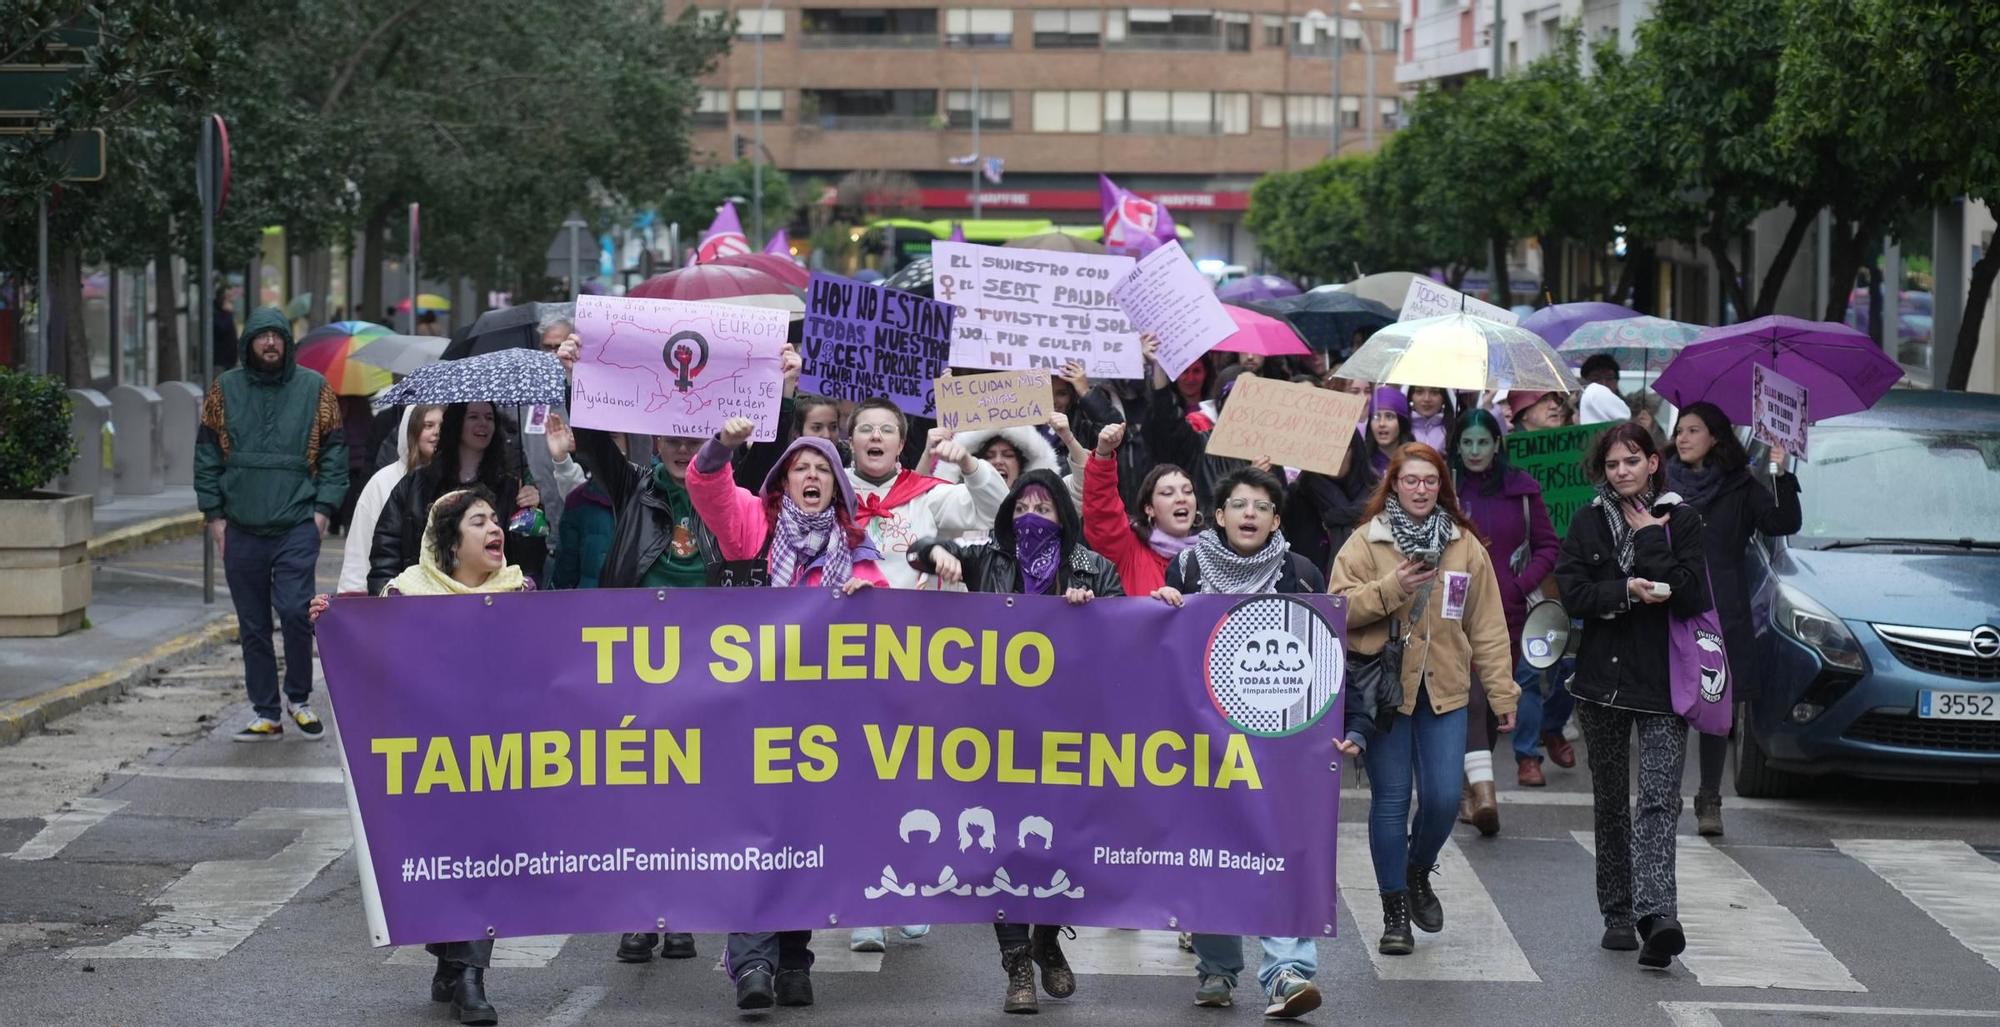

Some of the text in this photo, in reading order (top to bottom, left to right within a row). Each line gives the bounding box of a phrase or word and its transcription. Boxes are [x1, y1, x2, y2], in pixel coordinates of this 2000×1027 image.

[951, 254, 1110, 280] EL SINIESTRO CON
[812, 279, 853, 319] HOY
[856, 285, 878, 322] NO
[960, 279, 974, 290] EL
[982, 278, 1042, 299] SEAT
[578, 307, 787, 339] de toda EUROPA
[808, 316, 867, 345] TODAS
[974, 307, 1059, 328] TUVISTE
[1061, 311, 1091, 330] TÚ
[997, 331, 1029, 347] FUE
[1038, 337, 1092, 352] CULPA
[1103, 341, 1123, 352] DE
[990, 351, 1013, 367] MI
[730, 374, 777, 399] Tus 5€
[801, 358, 817, 377] LA
[888, 376, 922, 398] PUEDE
[941, 380, 964, 399] ME
[969, 379, 1012, 396] CUIDAN
[718, 395, 765, 412] pueden
[943, 400, 1042, 430] NO LA POLICÍA
[582, 623, 1055, 687] TU SILENCIO
[1238, 675, 1304, 685] TODAS A UNA
[1242, 686, 1300, 697] #Imparables8M
[1938, 693, 1995, 716] 3552
[371, 714, 1261, 795] TAMBIÉN ES VIOLENCIA
[401, 844, 825, 882] #AlEstadoPatriarcalFeminismoRadical
[1094, 846, 1286, 876] Plataforma 8M Badajoz
